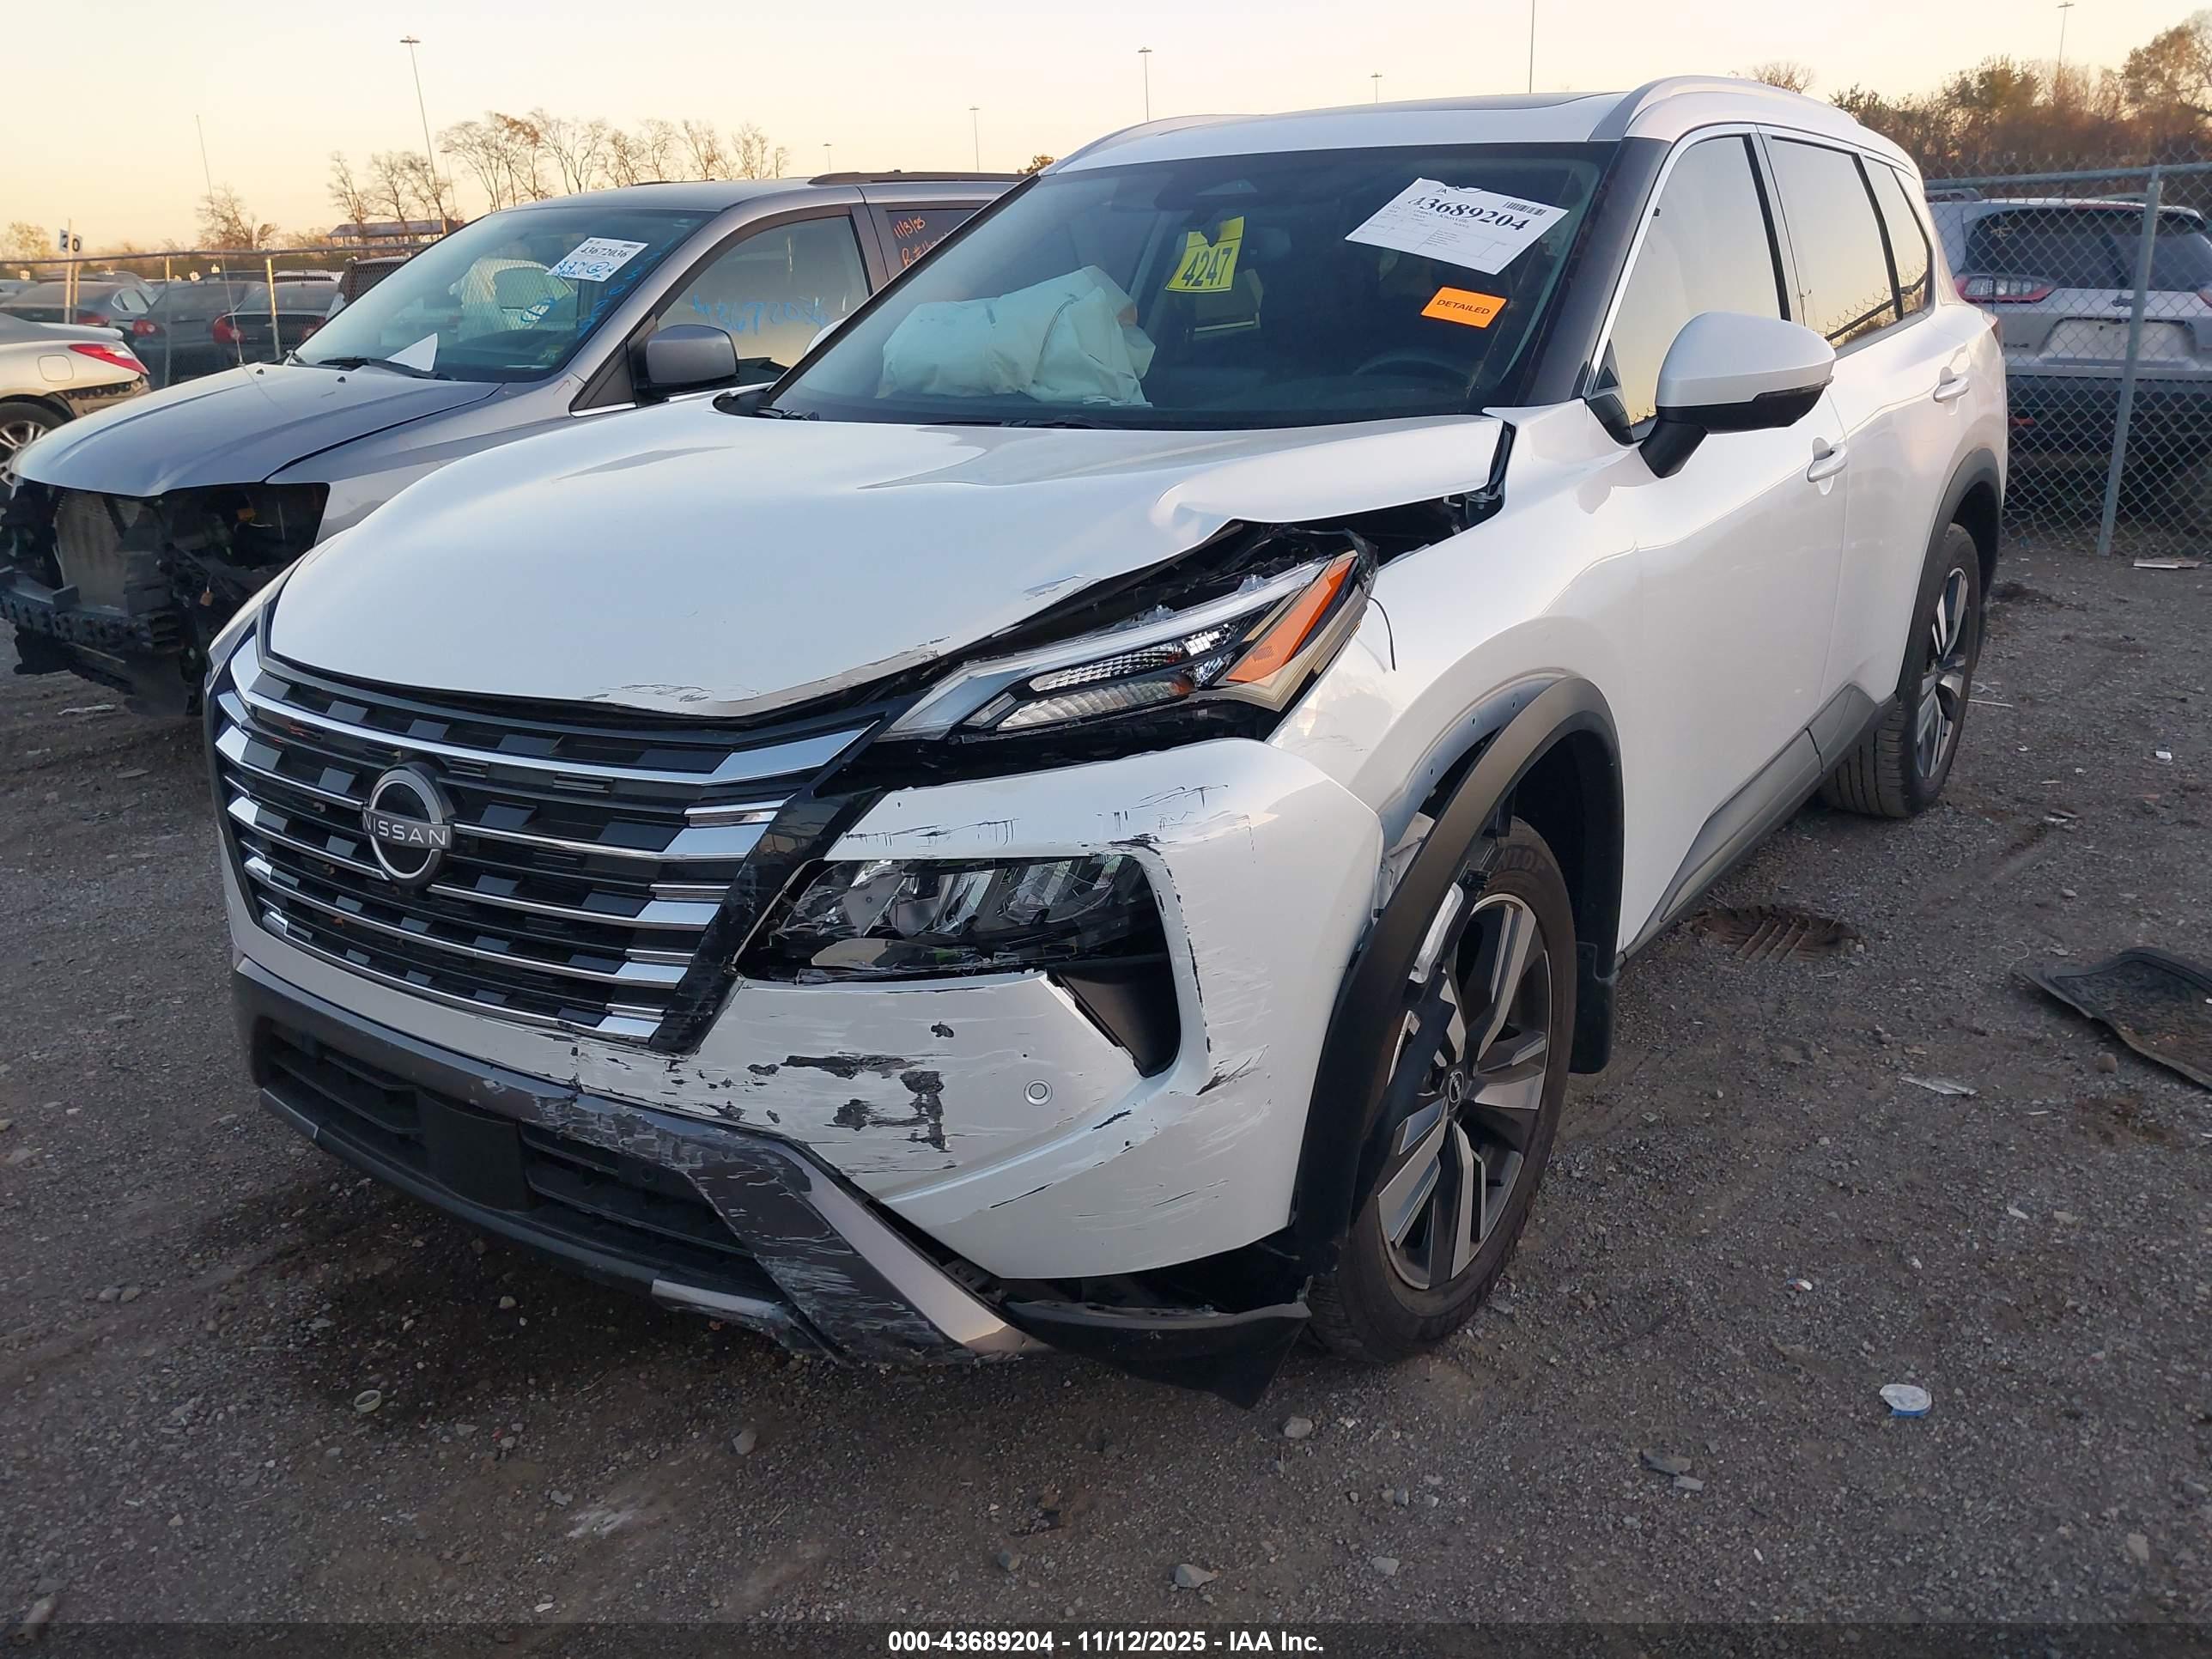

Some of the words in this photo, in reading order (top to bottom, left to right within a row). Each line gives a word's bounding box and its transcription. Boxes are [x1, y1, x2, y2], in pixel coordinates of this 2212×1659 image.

[1181, 247, 1233, 287] 4247
[1436, 298, 1491, 315] DETAILED
[363, 811, 446, 846] NISSAN
